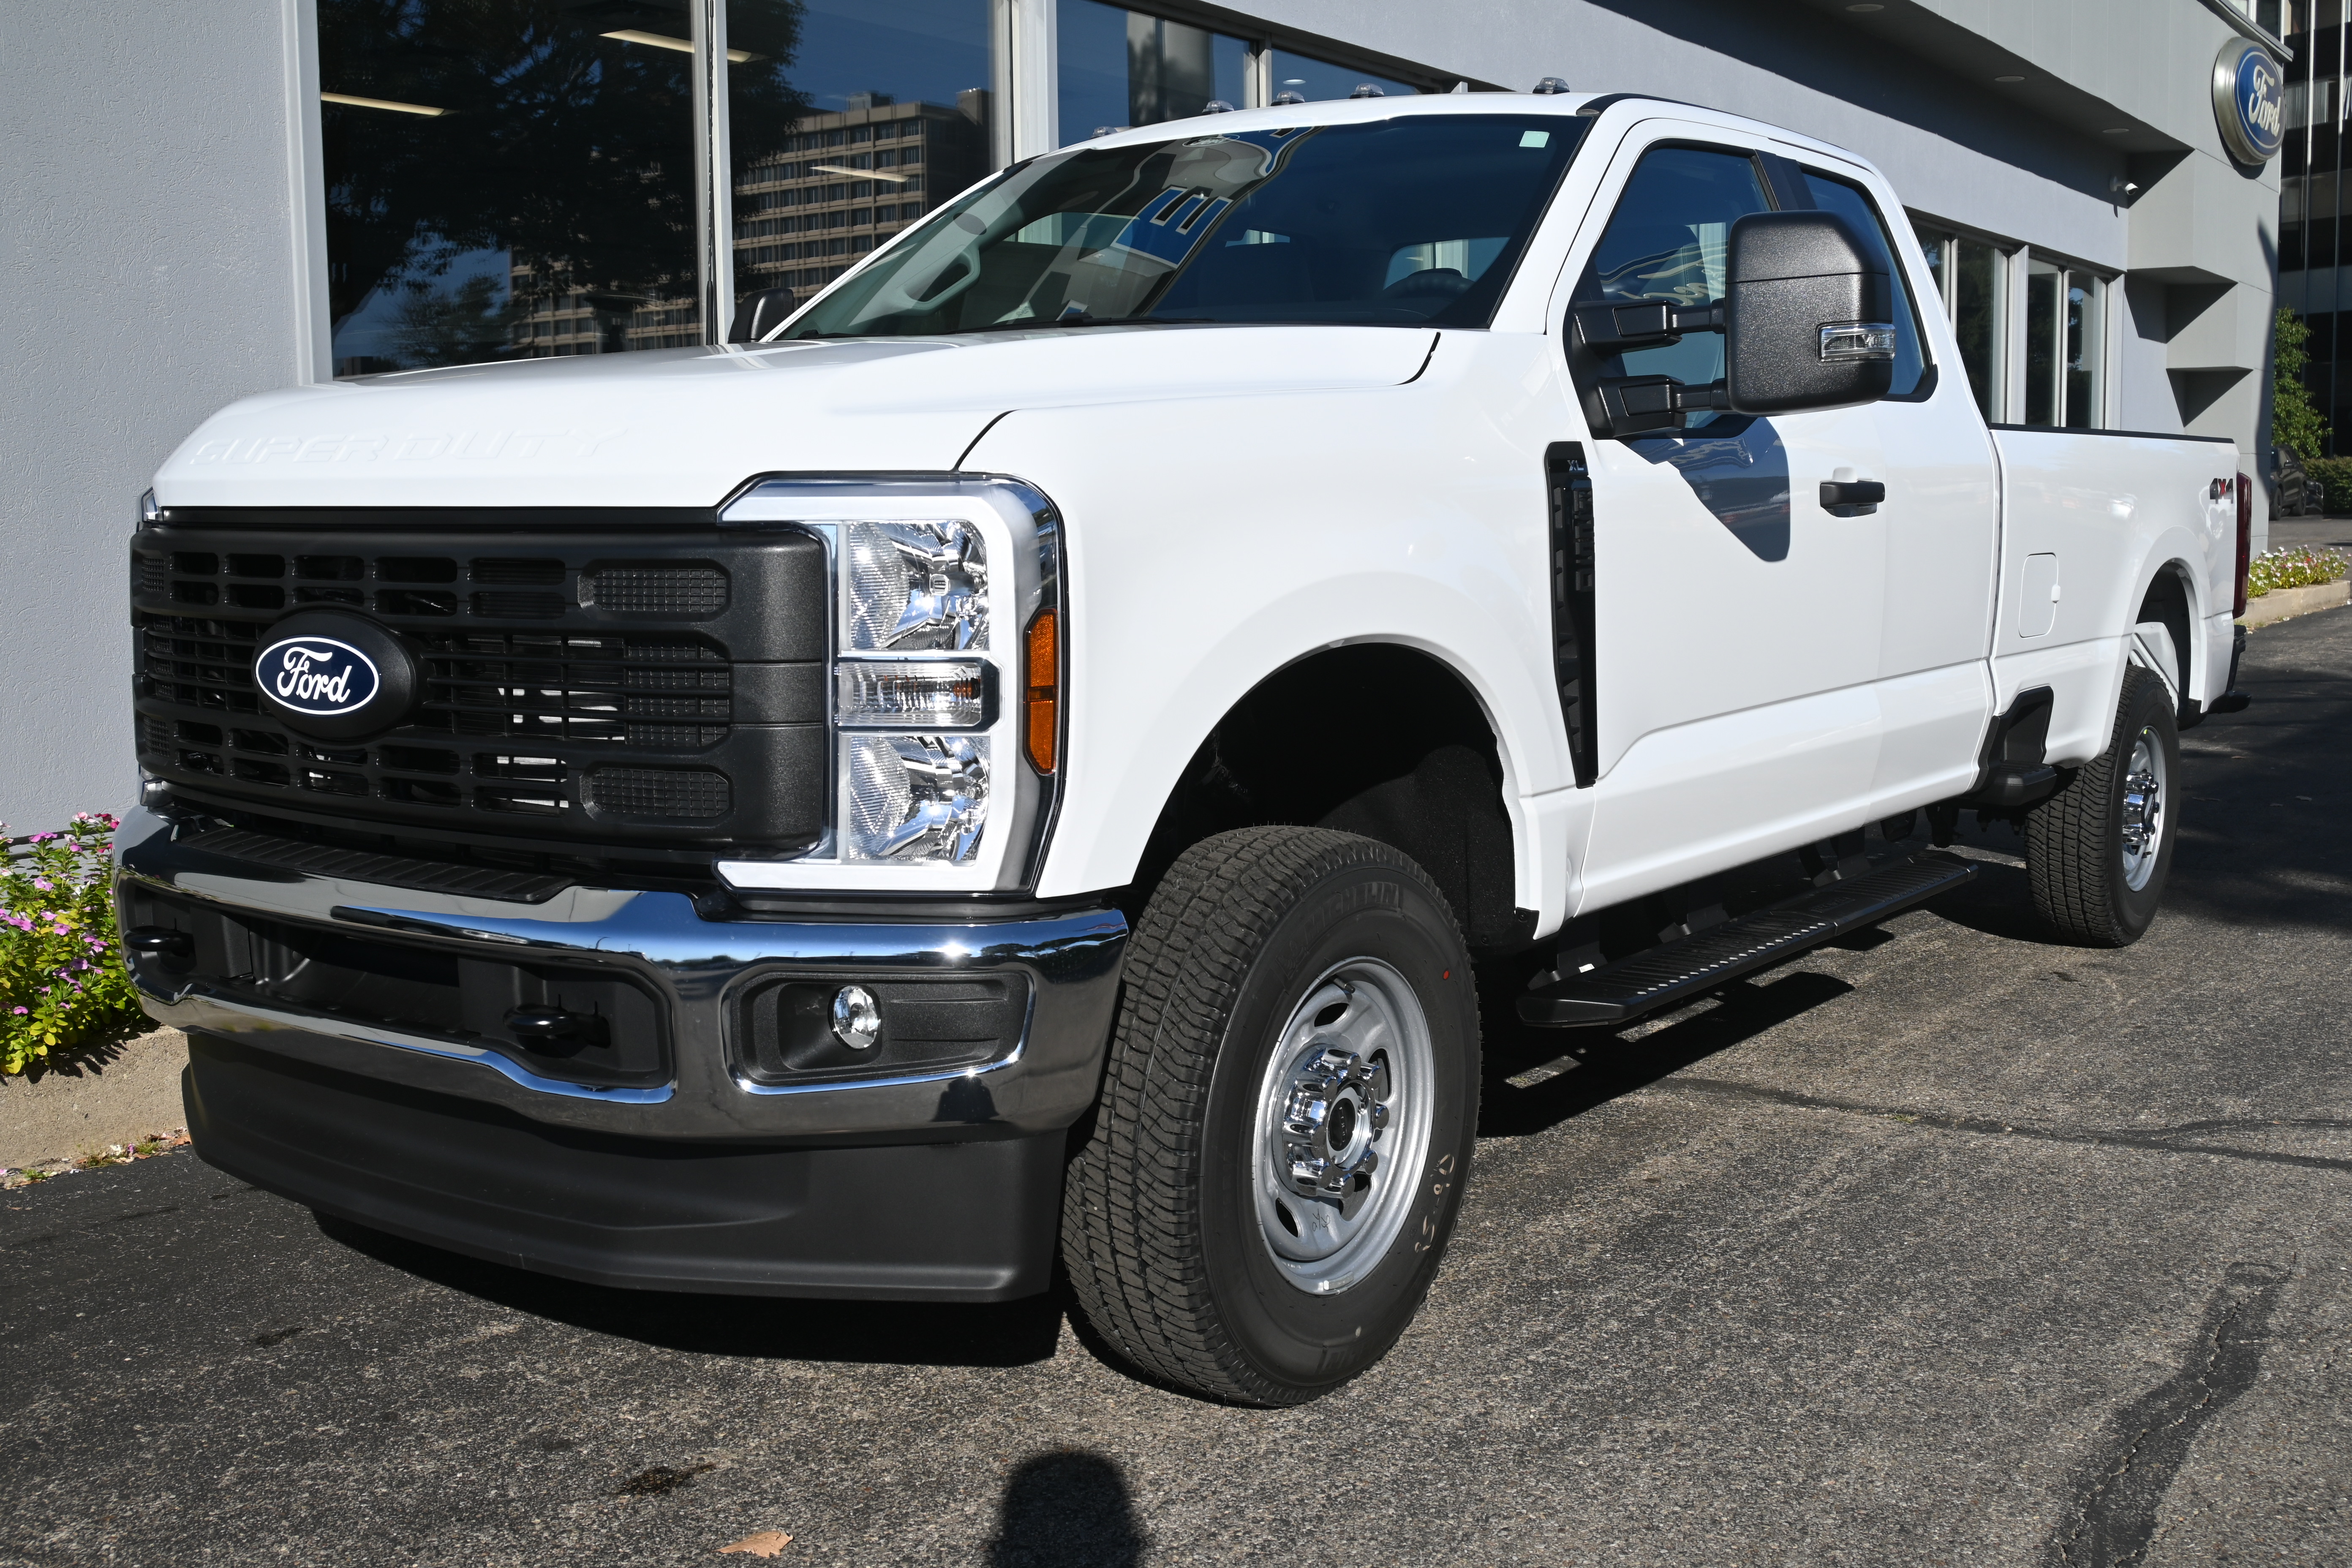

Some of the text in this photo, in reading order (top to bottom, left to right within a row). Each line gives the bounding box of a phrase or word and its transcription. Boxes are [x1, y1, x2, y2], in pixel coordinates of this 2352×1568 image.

[2249, 64, 2282, 137] Ford
[188, 427, 631, 466] SUPER DUTY
[1567, 459, 1585, 471] XL
[276, 646, 353, 704] Ford
[1303, 881, 1400, 945] MICHELIN
